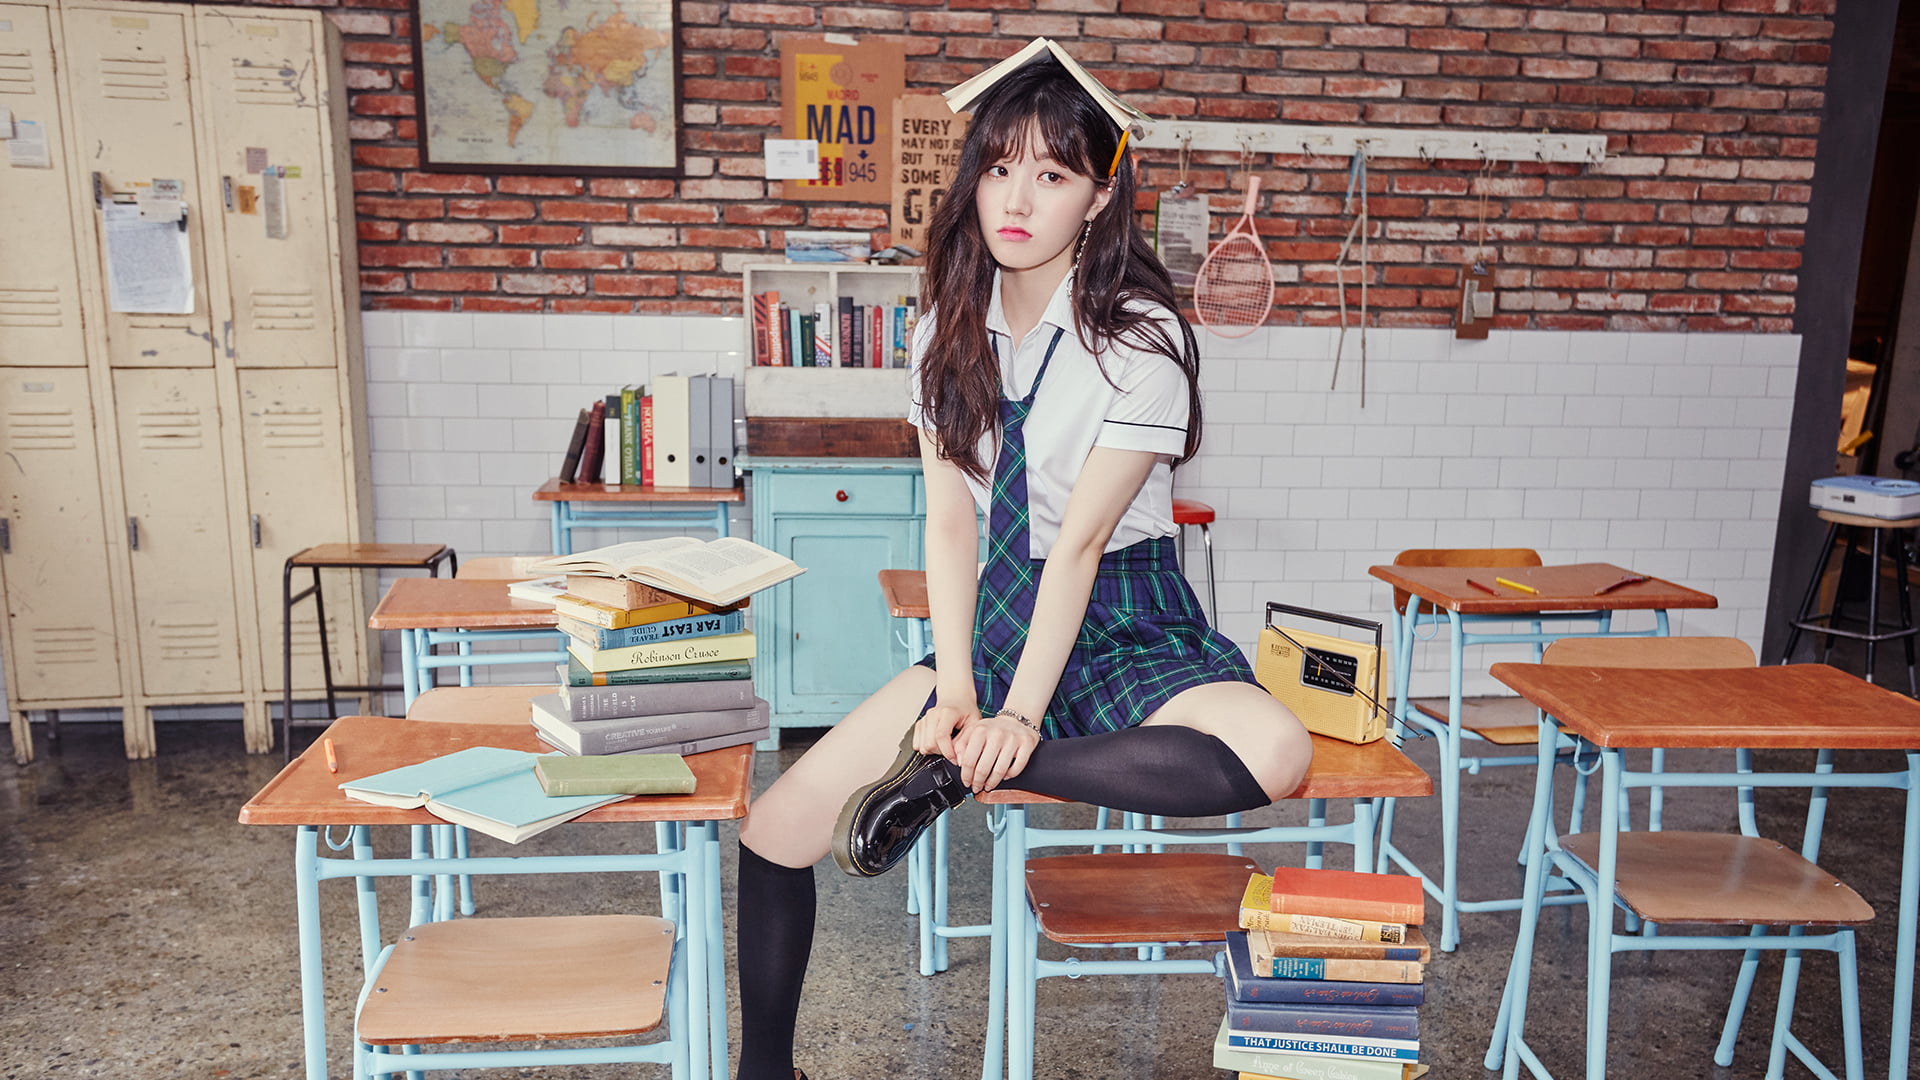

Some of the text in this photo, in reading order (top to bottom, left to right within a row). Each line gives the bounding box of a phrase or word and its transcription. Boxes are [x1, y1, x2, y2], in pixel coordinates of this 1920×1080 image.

[807, 105, 875, 144] MAD
[902, 118, 951, 136] EVERY
[901, 138, 926, 149] MAY
[929, 139, 950, 150] NOT
[902, 152, 923, 165] BUT
[901, 169, 941, 185] SOME
[901, 228, 913, 239] IN
[631, 625, 657, 635] GUIDE
[662, 619, 720, 637] FAR EAST
[630, 633, 659, 643] TRAVEL
[631, 646, 720, 664] Robinson Crusoe
[1244, 1036, 1397, 1058] THAT JUSTICE SHALL BE DONE
